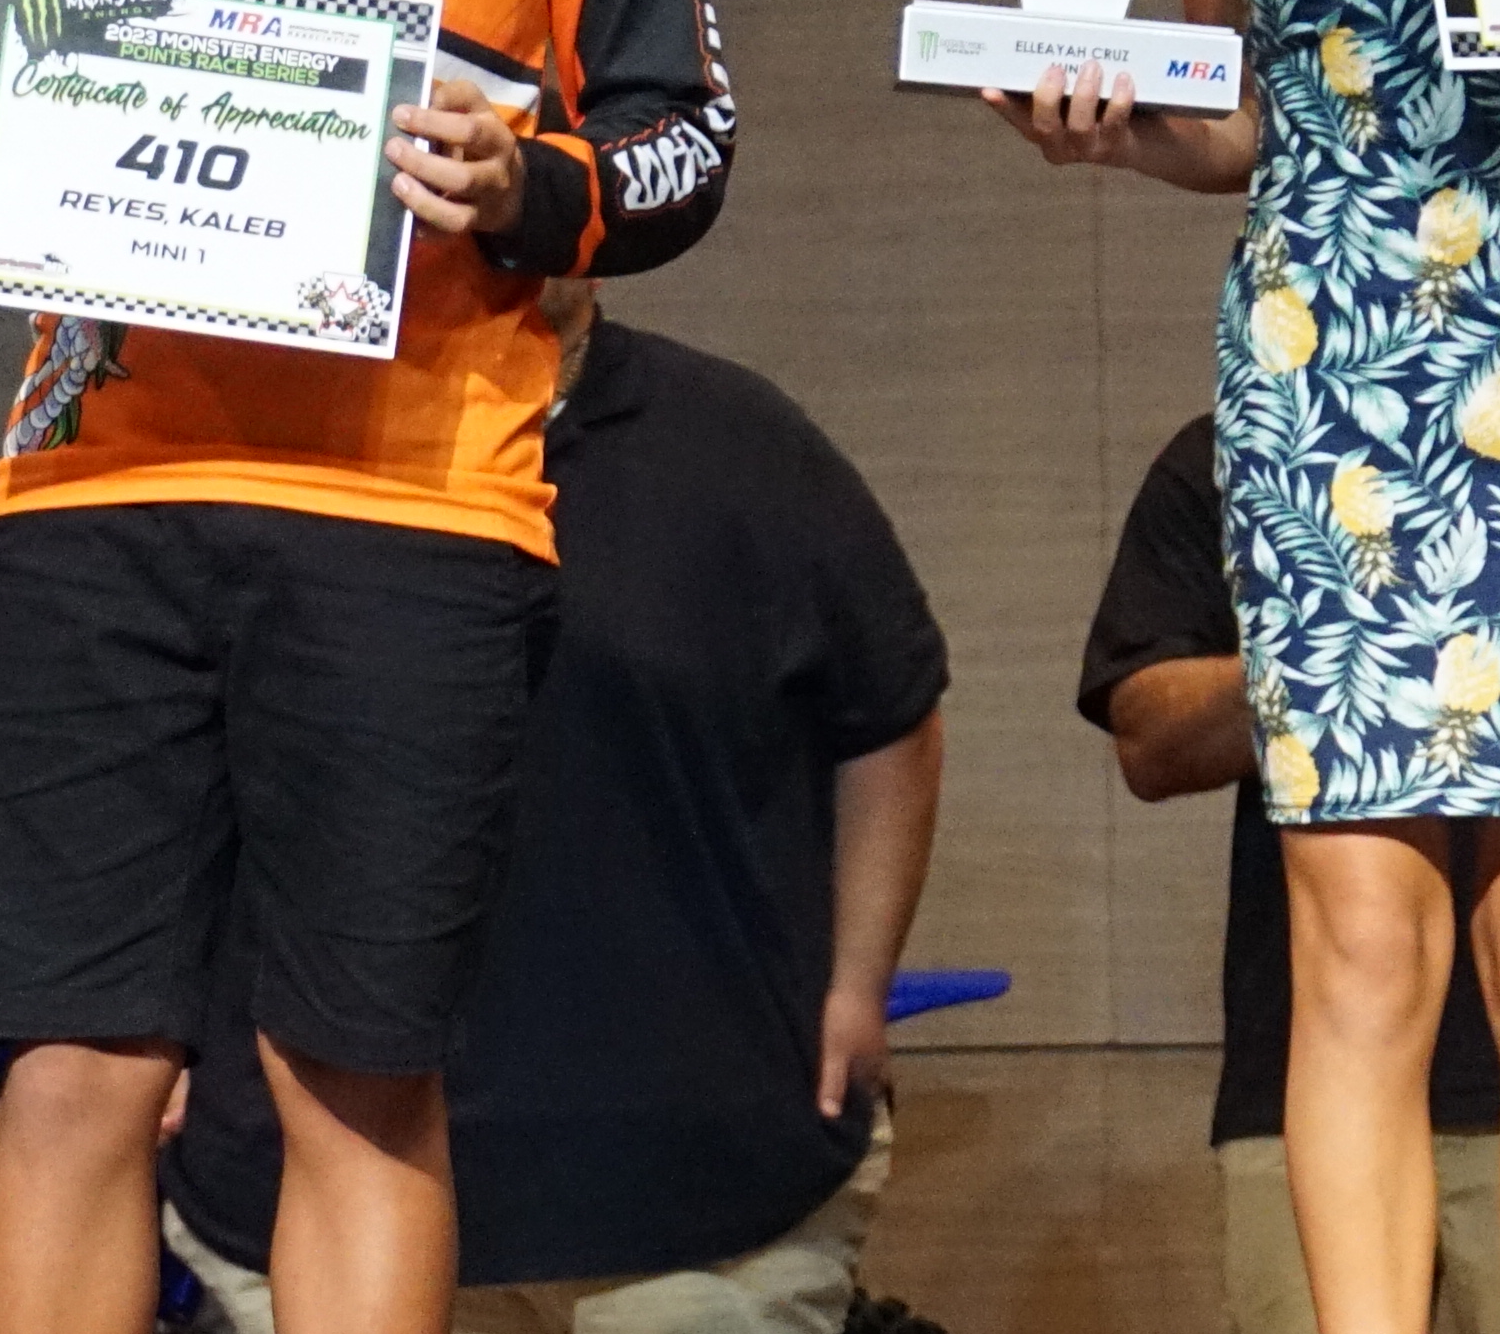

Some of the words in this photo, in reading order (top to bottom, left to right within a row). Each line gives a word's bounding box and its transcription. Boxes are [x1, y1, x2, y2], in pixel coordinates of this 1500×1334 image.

[209, 8, 282, 38] MRA
[105, 24, 157, 46] 2023
[161, 31, 257, 61] MONSTER
[262, 48, 339, 73] ENERGY
[120, 43, 192, 68] POINTS
[195, 53, 249, 76] RACE
[251, 62, 320, 85] SERIES
[1015, 40, 1086, 58] ELLEAYAH
[1092, 47, 1130, 62] CRUZ
[1166, 59, 1227, 82] MRA
[12, 59, 148, 114] Certificate
[159, 93, 188, 121] of
[201, 91, 372, 144] Appreciation
[114, 134, 250, 191] 410
[59, 189, 169, 226] REYES,
[179, 206, 286, 239] KALEB
[131, 240, 188, 262] MINI
[198, 248, 206, 265] 1
